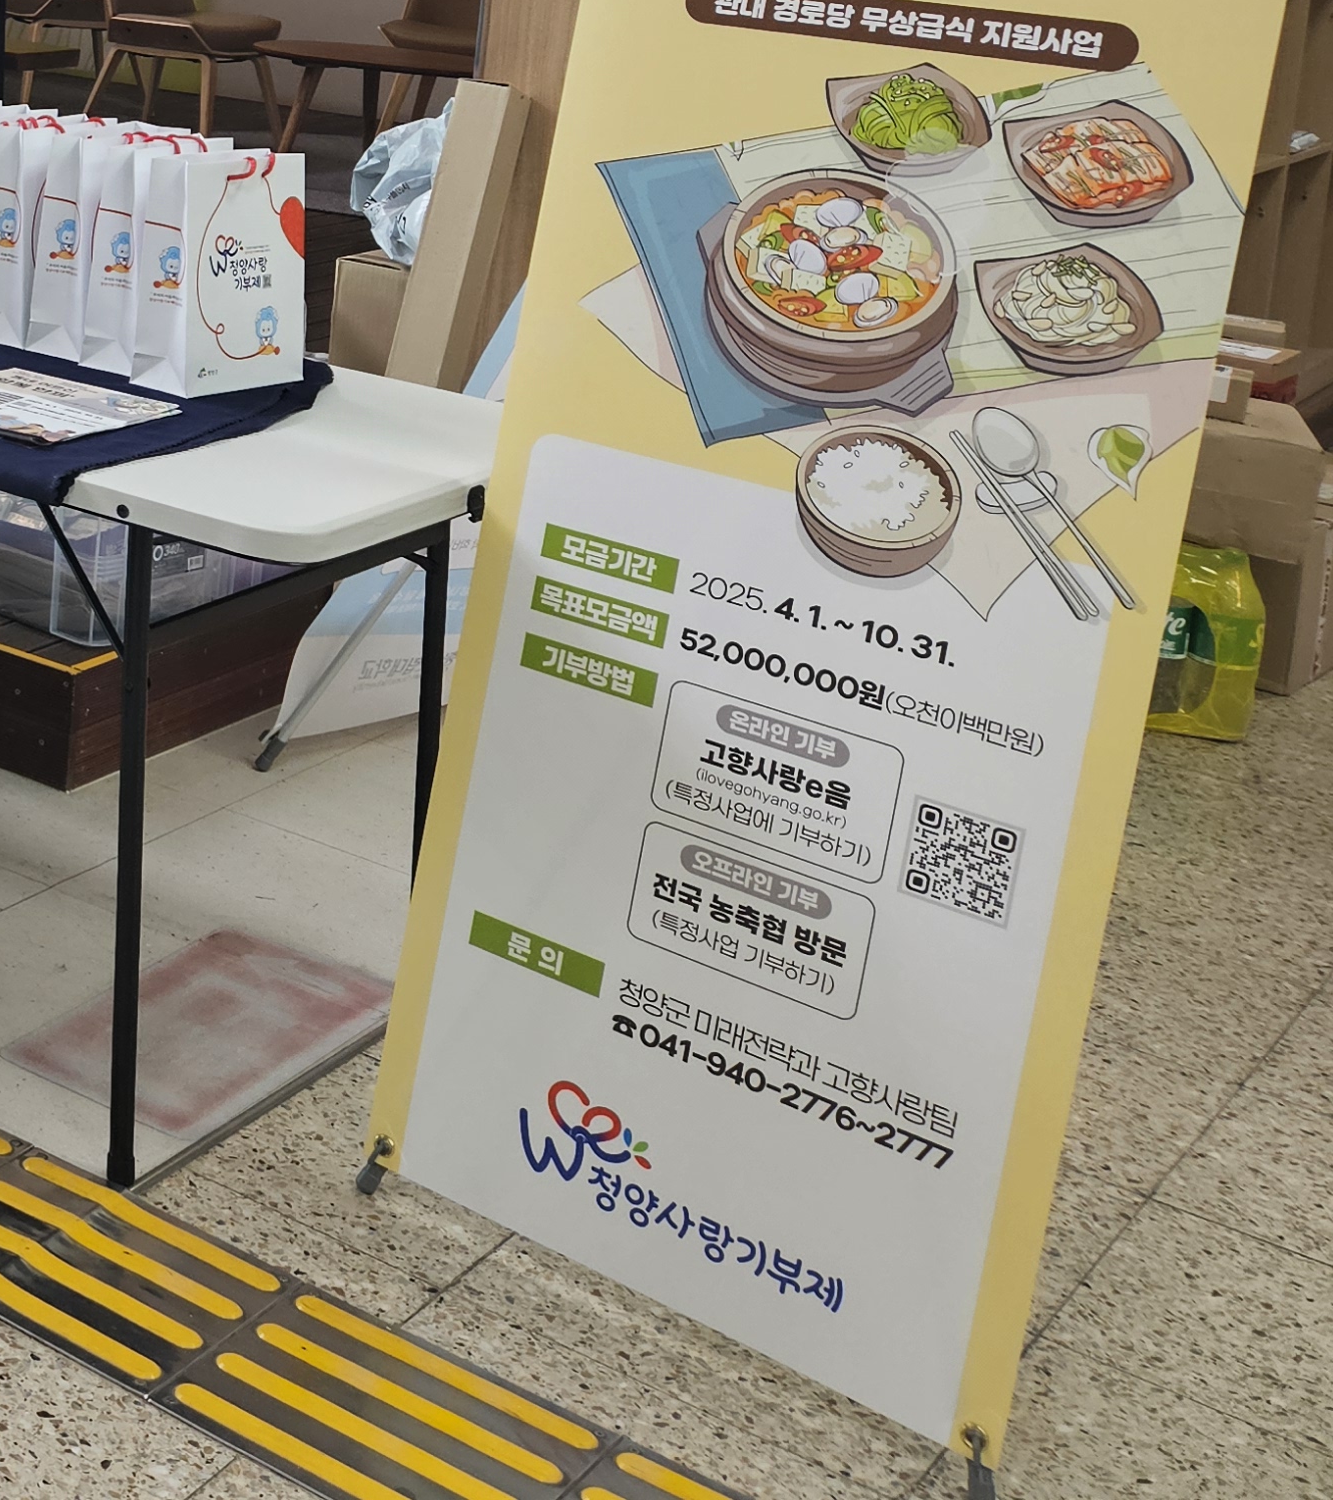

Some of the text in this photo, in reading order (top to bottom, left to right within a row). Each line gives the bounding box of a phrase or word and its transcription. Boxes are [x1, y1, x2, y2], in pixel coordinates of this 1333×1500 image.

[861, 3, 974, 46] 무상급식
[980, 17, 1103, 60] 지원사업
[229, 257, 267, 276] 청양사랑
[234, 277, 261, 292] 기부제
[560, 532, 657, 583] 모금기간
[539, 585, 658, 644] 목표모금액
[689, 571, 769, 616] 2025.
[774, 597, 801, 626] 4.
[807, 605, 827, 632] 1.
[862, 620, 904, 653] 10.
[911, 632, 956, 668] 31.
[541, 642, 637, 698] 기부방법
[729, 709, 837, 761] 온라인 기부
[695, 767, 847, 831] (ilovegohyang.go.kr)
[699, 738, 852, 810] 고향사랑e음
[664, 778, 872, 869] (특정사업에 기부하기)
[692, 850, 819, 911] 오프라인 기부
[652, 873, 847, 968] 전국 농축협 방문
[651, 908, 835, 998] (특정사업 기부하기)
[619, 977, 959, 1139] 청양군 미래전략과 고향사랑팀
[587, 1165, 845, 1313] 청양사랑기부제
